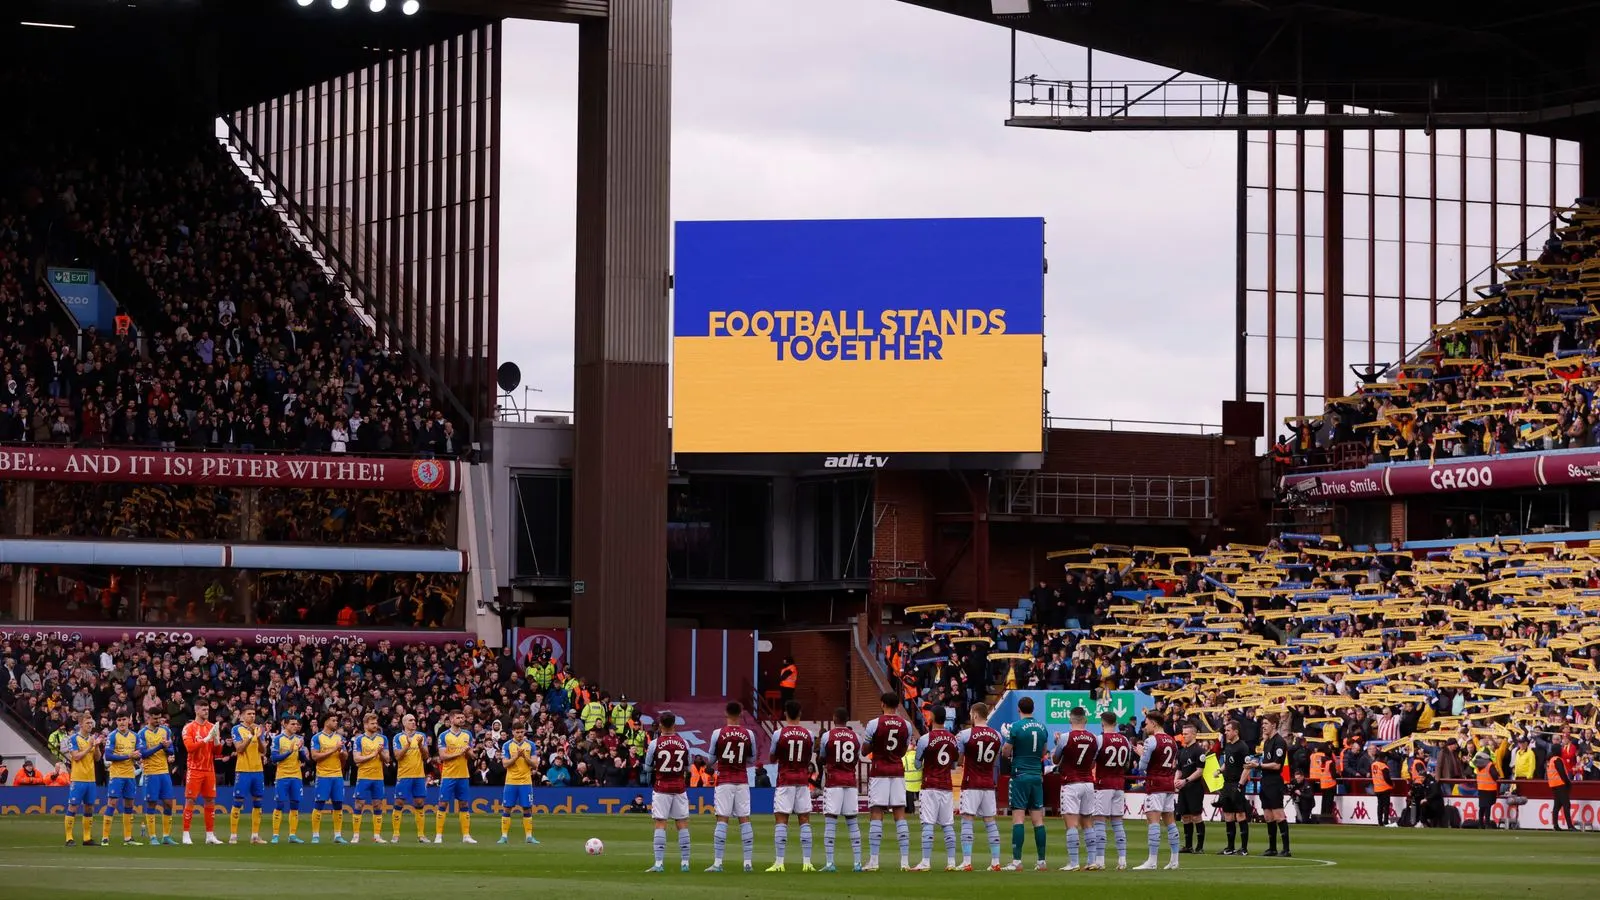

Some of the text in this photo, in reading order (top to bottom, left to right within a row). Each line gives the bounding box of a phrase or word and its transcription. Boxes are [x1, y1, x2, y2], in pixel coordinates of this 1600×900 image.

[708, 308, 1007, 337] FOOTBALL STANDS
[770, 334, 943, 361] TOGETHER
[64, 454, 121, 474] AND
[129, 456, 155, 475] IT
[163, 457, 193, 476] IS!
[201, 457, 280, 479] PETER
[286, 460, 385, 482] WITHE!!
[824, 453, 889, 468] adi.tv
[1321, 481, 1350, 495] Drive.
[1350, 478, 1381, 492] Smile.
[1430, 466, 1493, 490] CAZOO
[1050, 698, 1072, 708] Fire
[1050, 709, 1071, 719] exit
[657, 739, 686, 750] COUTINHO
[725, 731, 749, 741] RAMSEY
[783, 730, 808, 740] WATKINS
[833, 731, 854, 739] YOUNG
[886, 729, 899, 751] 5
[1031, 730, 1038, 752] 1
[657, 749, 686, 772] 23
[721, 741, 745, 764] 41
[787, 739, 804, 762] 11
[833, 740, 855, 763] 18
[937, 743, 950, 766] 6
[976, 740, 995, 763] 16
[1077, 743, 1090, 765] 7
[1105, 745, 1129, 767] 20
[1162, 746, 1173, 768] 2
